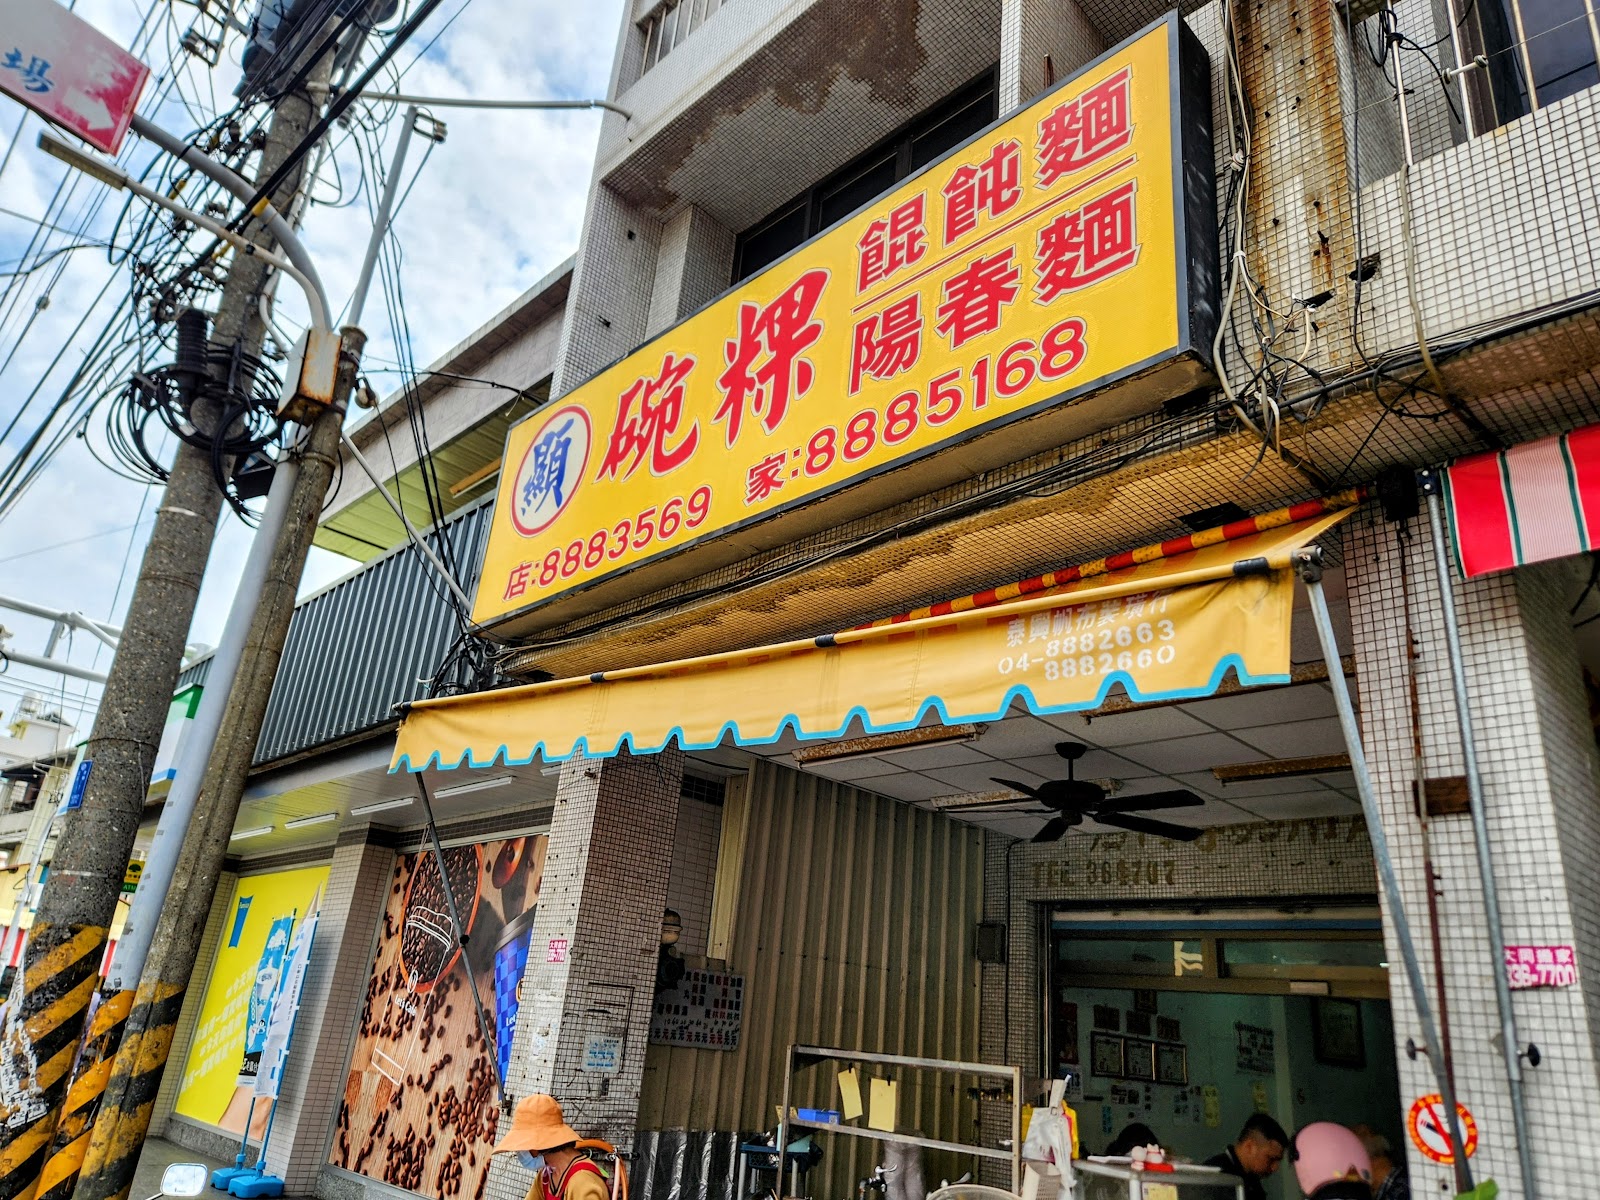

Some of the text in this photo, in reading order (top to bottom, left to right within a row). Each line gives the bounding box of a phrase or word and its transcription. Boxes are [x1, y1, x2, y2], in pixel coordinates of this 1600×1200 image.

[849, 179, 1141, 396] 陽春麵
[856, 64, 1133, 296] 餛飩麵
[595, 268, 832, 483] 碗粿
[1046, 619, 1175, 657] 8882663
